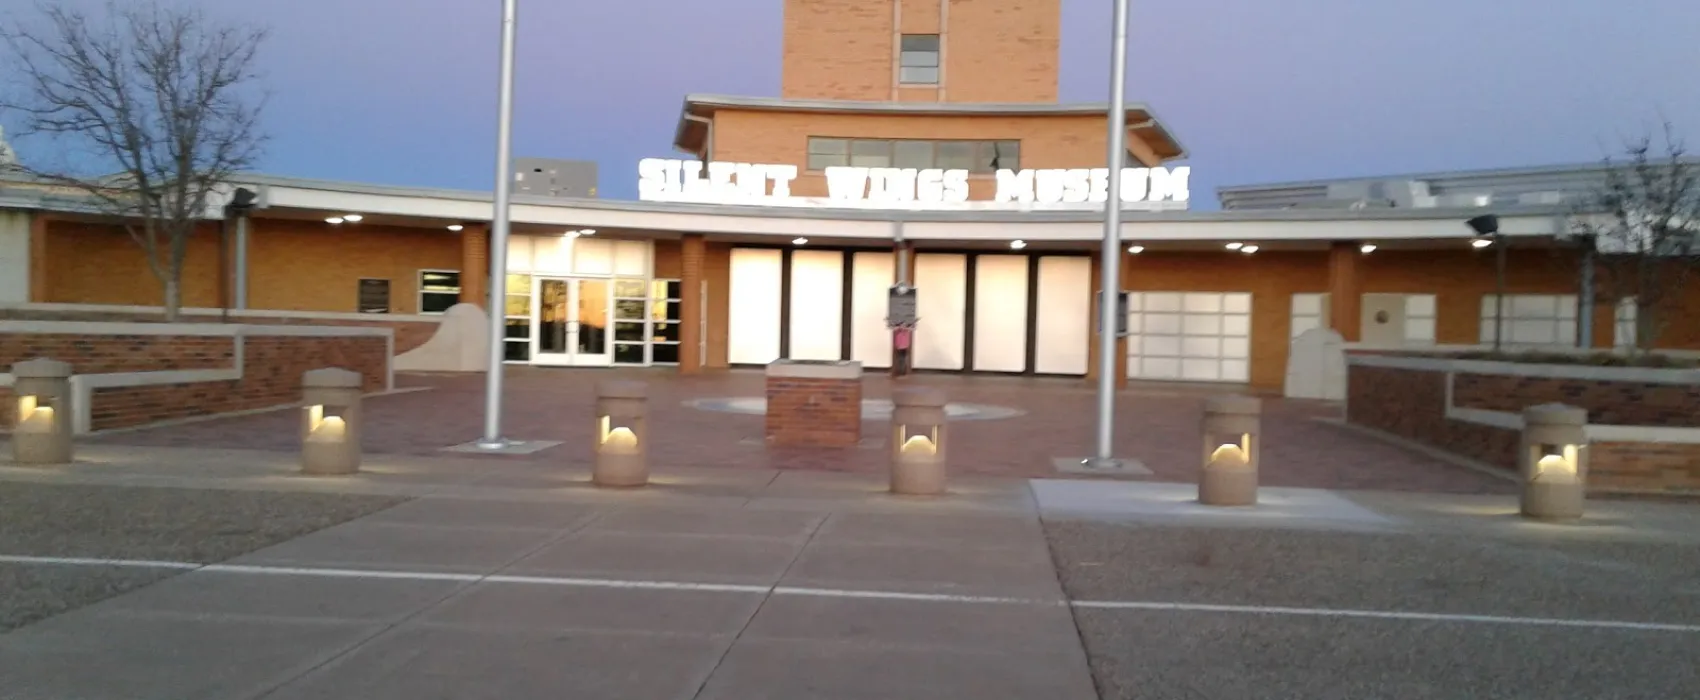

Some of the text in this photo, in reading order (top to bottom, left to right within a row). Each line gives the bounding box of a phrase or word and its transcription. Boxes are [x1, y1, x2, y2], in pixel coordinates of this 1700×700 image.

[639, 158, 1190, 203] SILENT WINGS MUSEUM
